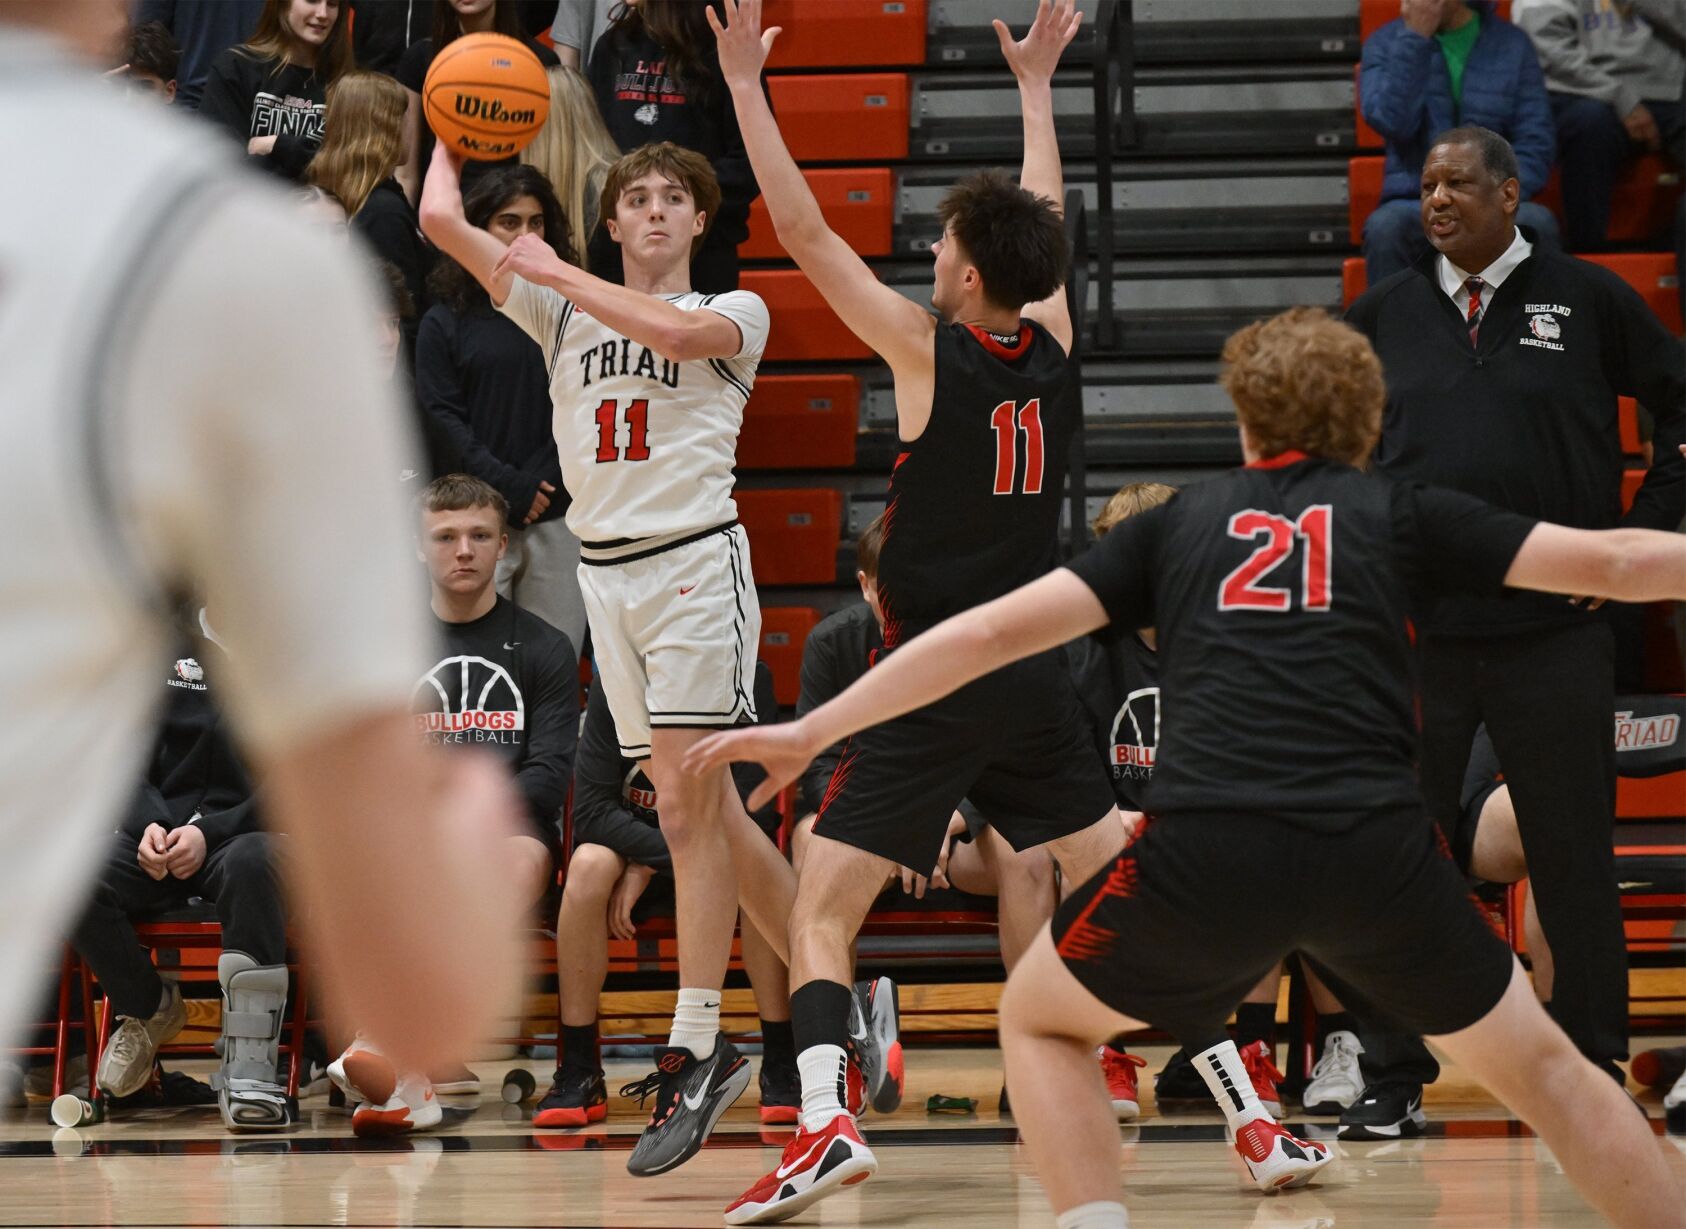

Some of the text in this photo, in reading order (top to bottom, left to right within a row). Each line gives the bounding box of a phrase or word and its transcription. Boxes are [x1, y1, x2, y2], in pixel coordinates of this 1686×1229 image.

[455, 93, 535, 124] Wilson
[1524, 303, 1572, 317] HIGHLAND
[1519, 337, 1565, 351] BASKETBALL
[580, 338, 680, 389] TRIAD
[594, 398, 651, 464] 11
[990, 397, 1045, 495] 11
[1217, 503, 1333, 612] 21
[167, 679, 207, 691] BASKETBALL
[415, 711, 516, 731] BULLDOGS
[1615, 715, 1675, 748] RIAD
